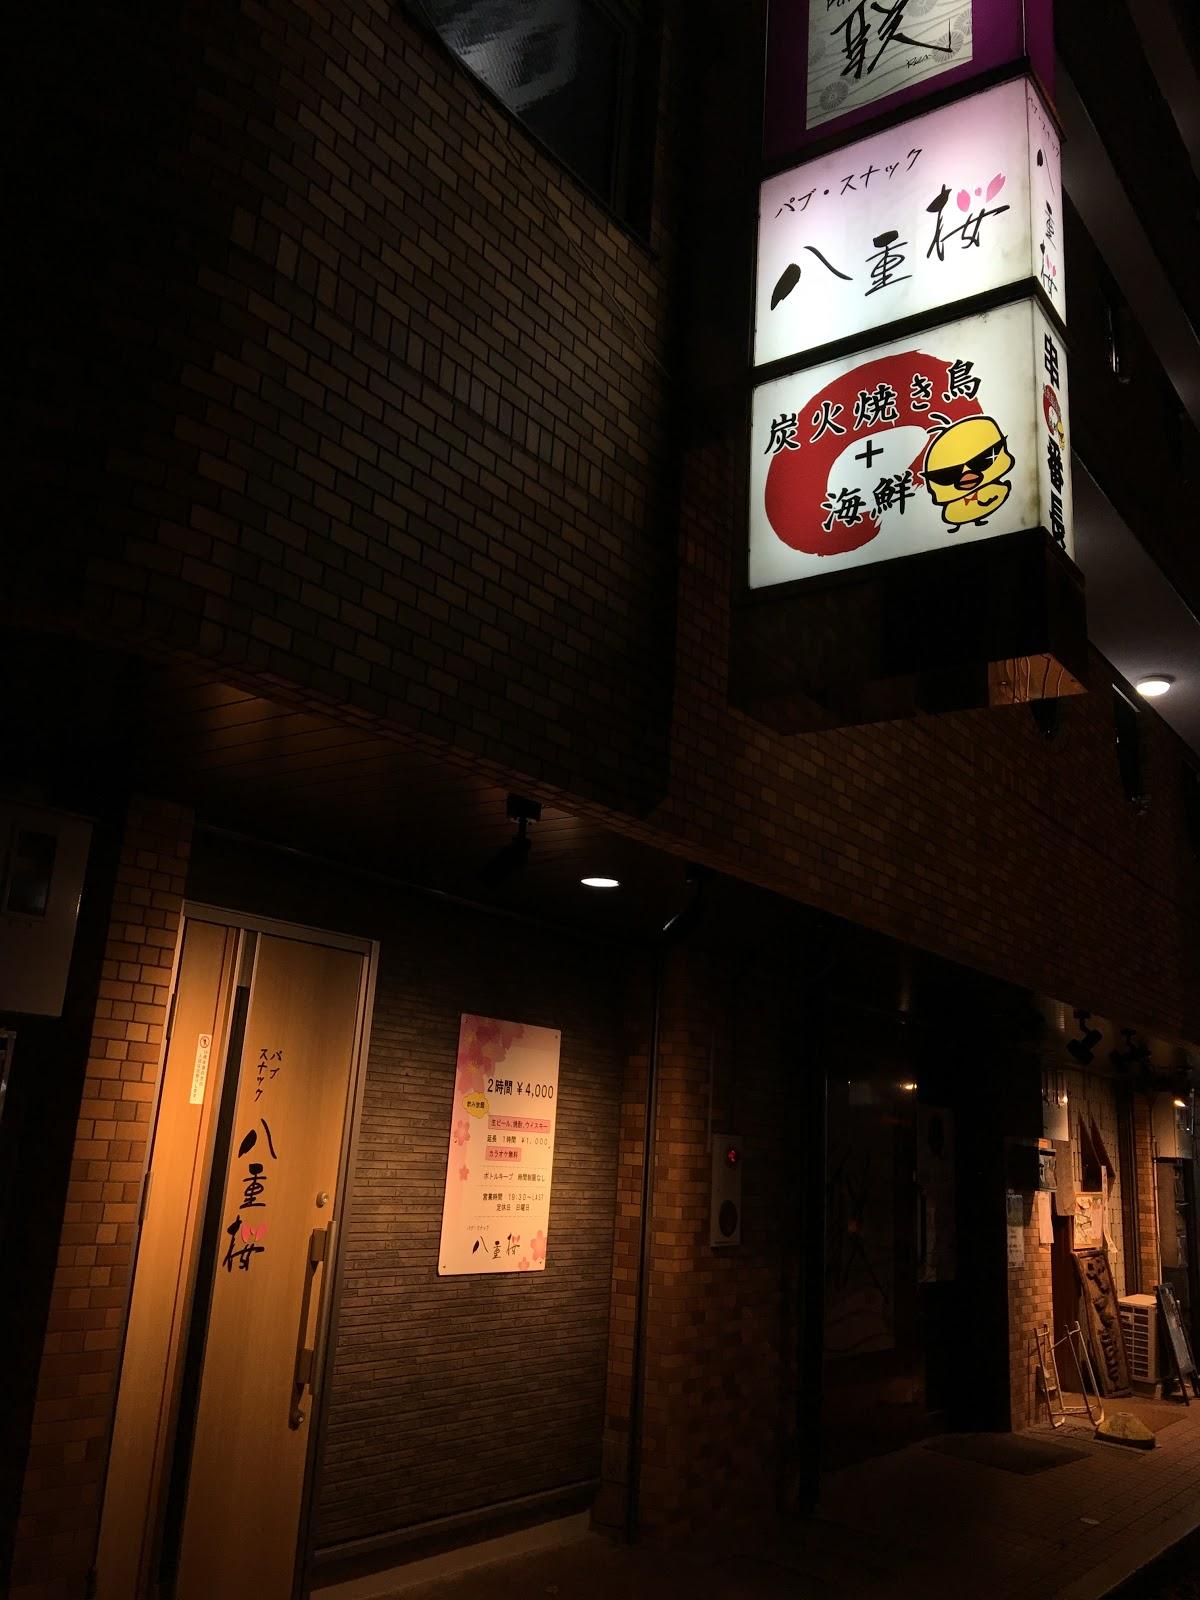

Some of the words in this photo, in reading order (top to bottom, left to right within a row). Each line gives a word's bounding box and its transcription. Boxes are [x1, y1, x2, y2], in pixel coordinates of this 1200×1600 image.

[774, 148, 923, 219] パブ・スナック
[770, 172, 1010, 311] 八重桜
[764, 359, 982, 455] 炭火焼き鳥
[820, 470, 916, 532] 海鮮
[254, 1048, 268, 1102] スナック
[270, 1049, 282, 1080] パブ
[487, 1078, 513, 1096] 2時間
[516, 1080, 554, 1099] ¥4,000
[222, 1118, 277, 1273] 八重桜
[515, 1203, 530, 1212] 日曜日
[472, 1232, 521, 1260] 八重桜
